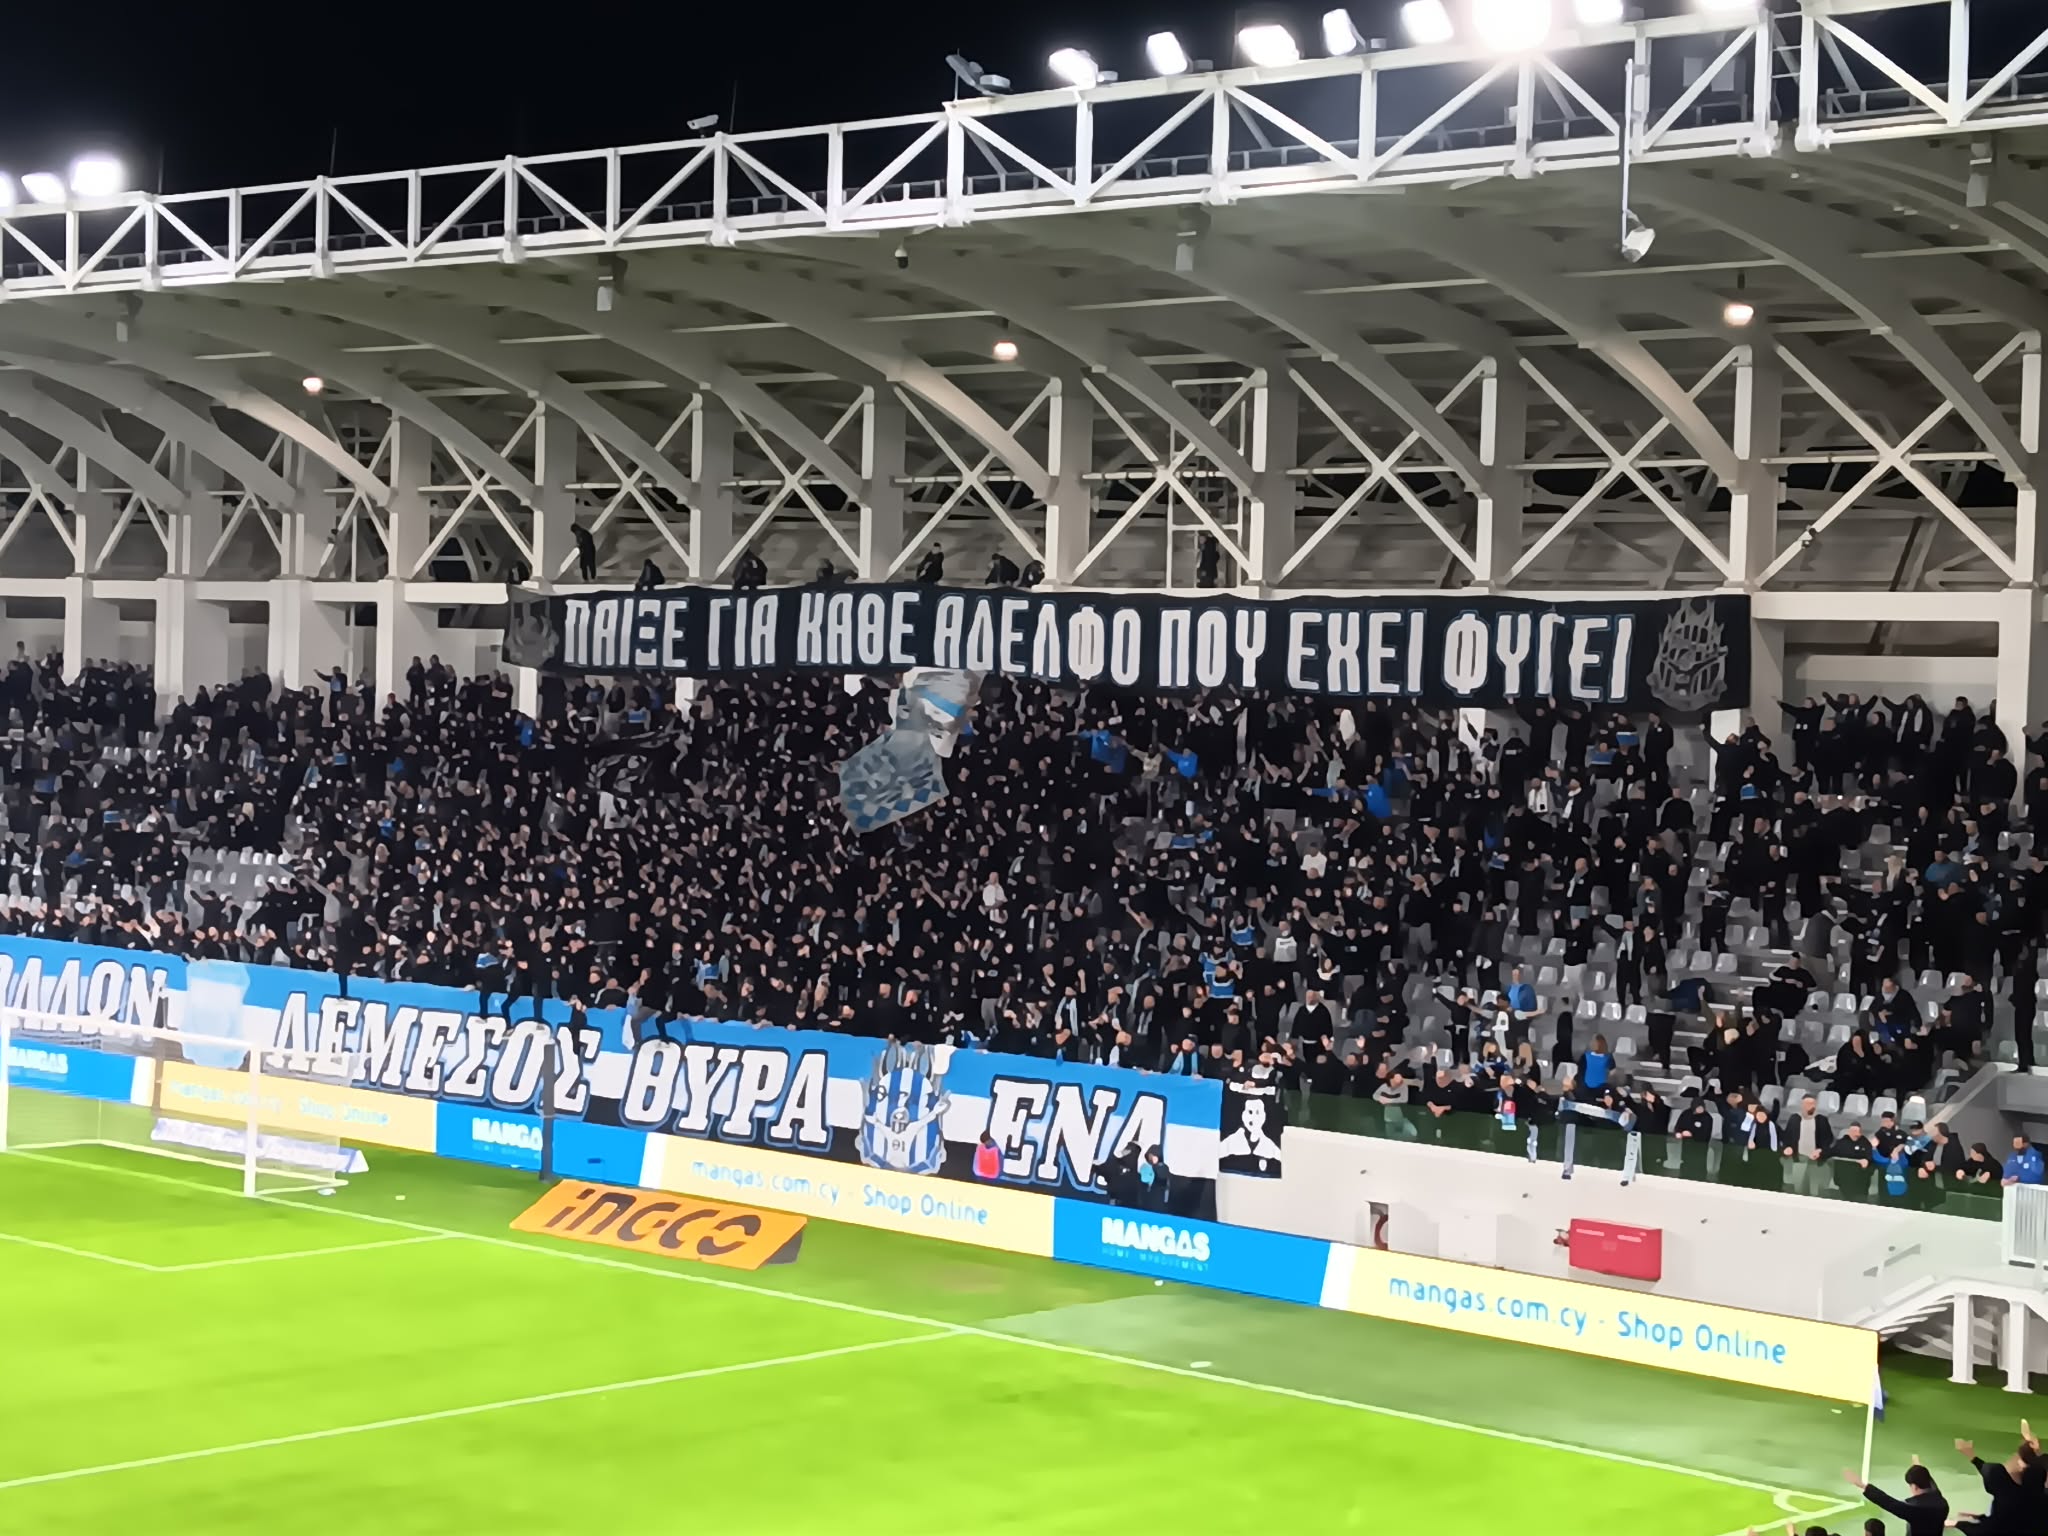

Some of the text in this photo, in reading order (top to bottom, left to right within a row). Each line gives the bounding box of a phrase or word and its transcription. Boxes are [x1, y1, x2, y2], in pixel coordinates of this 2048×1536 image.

[563, 590, 1635, 700] ΠΑΙΞΕ ΓΙΑ ΚΑΘΕ ΑΔΕΛΦΟ ΠΟΥ ΕΧΕΙ ΦΥΓΕΙ
[623, 1037, 829, 1144] ΘΥΡΑ
[471, 1117, 543, 1151] MANGA
[862, 1184, 913, 1216] Shop
[920, 1193, 989, 1226] Online
[1101, 1216, 1211, 1262] MANGAS
[1617, 1309, 1684, 1351] Shop
[1695, 1323, 1787, 1365] Online
